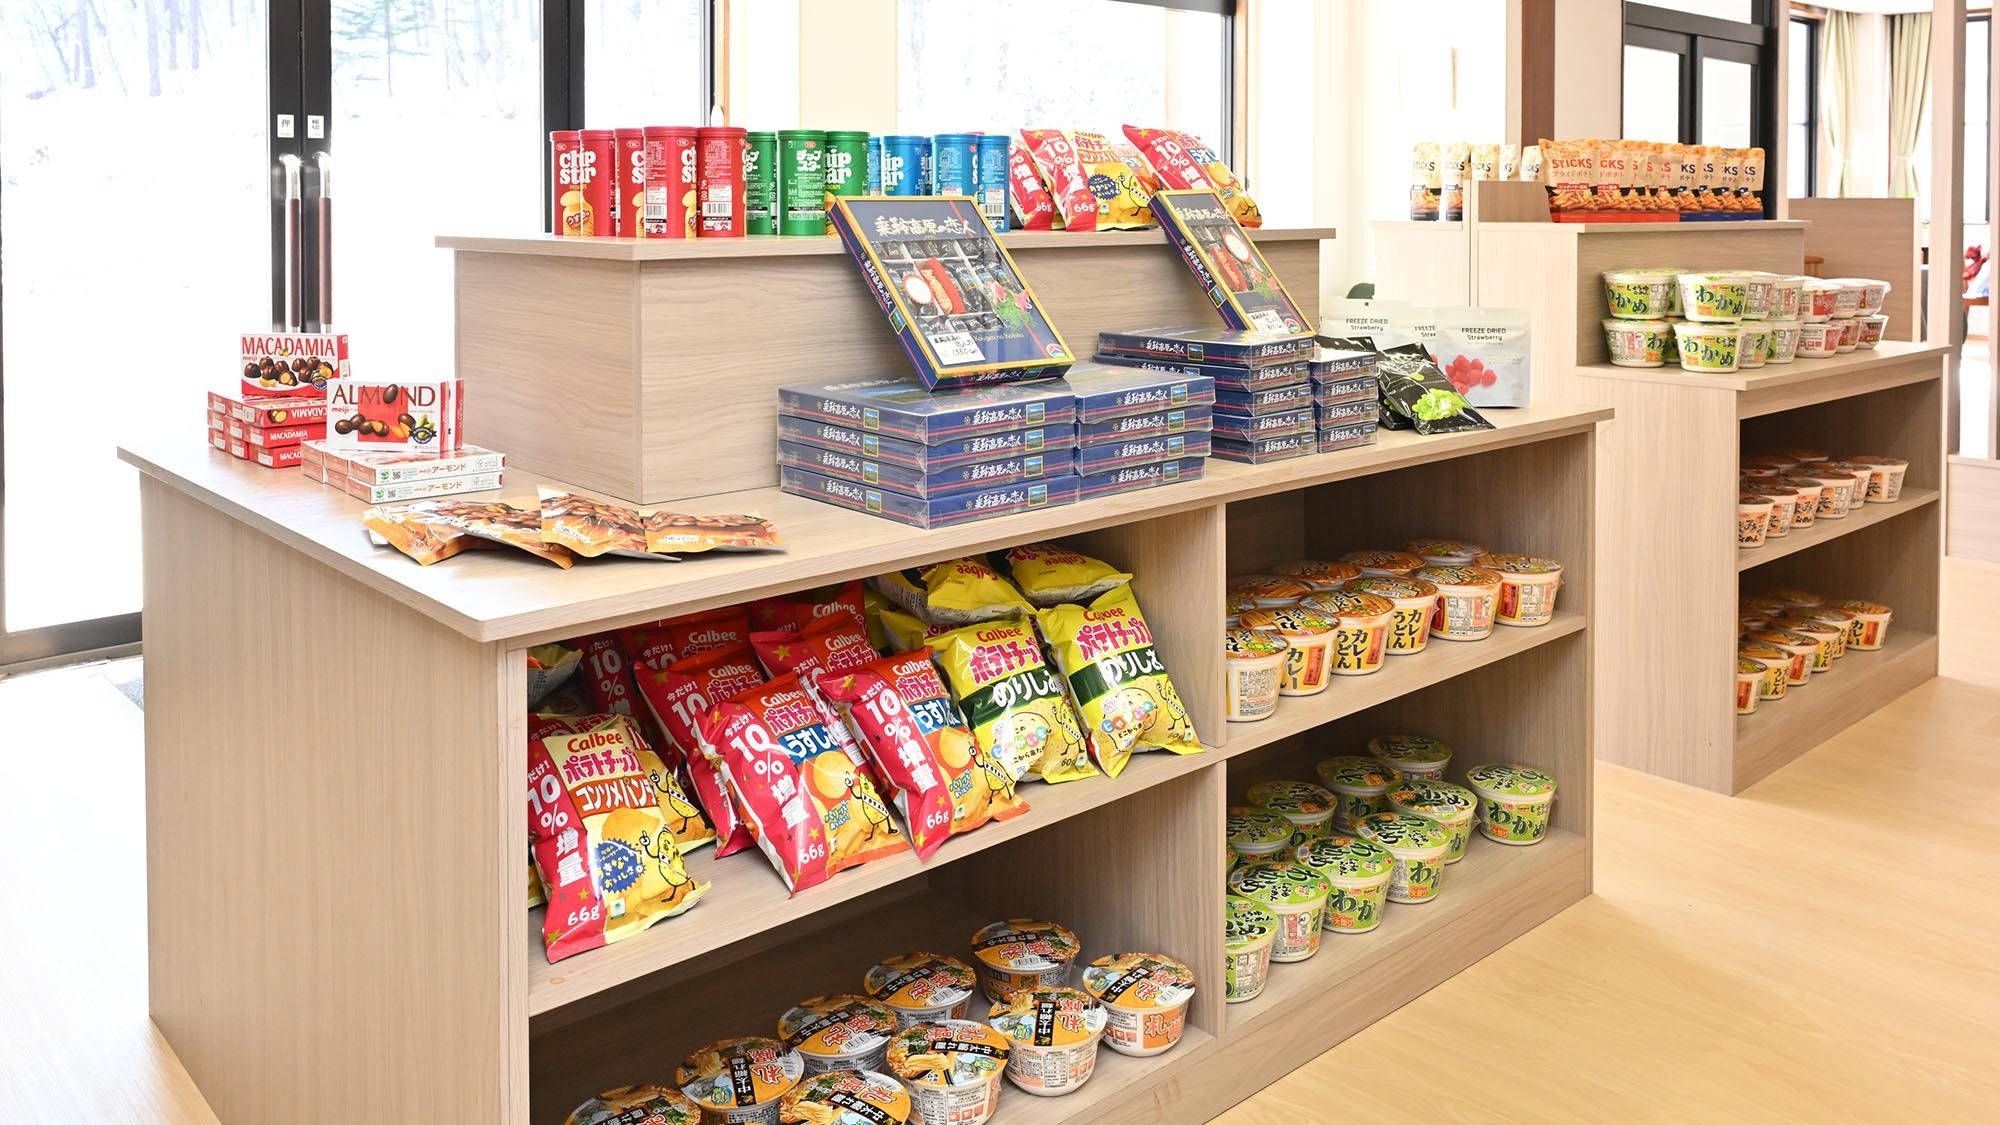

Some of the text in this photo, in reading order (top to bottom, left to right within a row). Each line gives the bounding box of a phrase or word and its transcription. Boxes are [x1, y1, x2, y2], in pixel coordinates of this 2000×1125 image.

[1552, 158, 1593, 170] STICKS
[1345, 317, 1389, 325] FREEZE DRIED
[1350, 324, 1384, 332] Strawberry
[1461, 327, 1507, 335] FREEZE DRIED
[241, 336, 336, 357] MACADAMIA
[1467, 333, 1503, 341] Strawberry
[1683, 335, 1735, 367] わかめ
[332, 383, 436, 408] ALMOND
[270, 430, 308, 441] MACADAMIA
[431, 462, 467, 475] アーモンド
[427, 480, 463, 493] アーモンド
[688, 630, 738, 645] Calbee
[976, 626, 1024, 644] Calbee
[1392, 610, 1407, 649] うどん
[1408, 609, 1423, 650] カレー
[824, 632, 865, 652] Calbee
[1336, 629, 1352, 670] うどん
[1351, 628, 1369, 671] カレー
[707, 662, 754, 680] Calbee
[891, 659, 934, 677] Calbee
[1287, 647, 1305, 690] カレー
[865, 688, 902, 726] 10
[566, 732, 624, 754] Calbee
[730, 722, 771, 764] 10
[926, 809, 950, 829] 66g
[1488, 801, 1547, 839] わかめ
[567, 904, 600, 926] 66g
